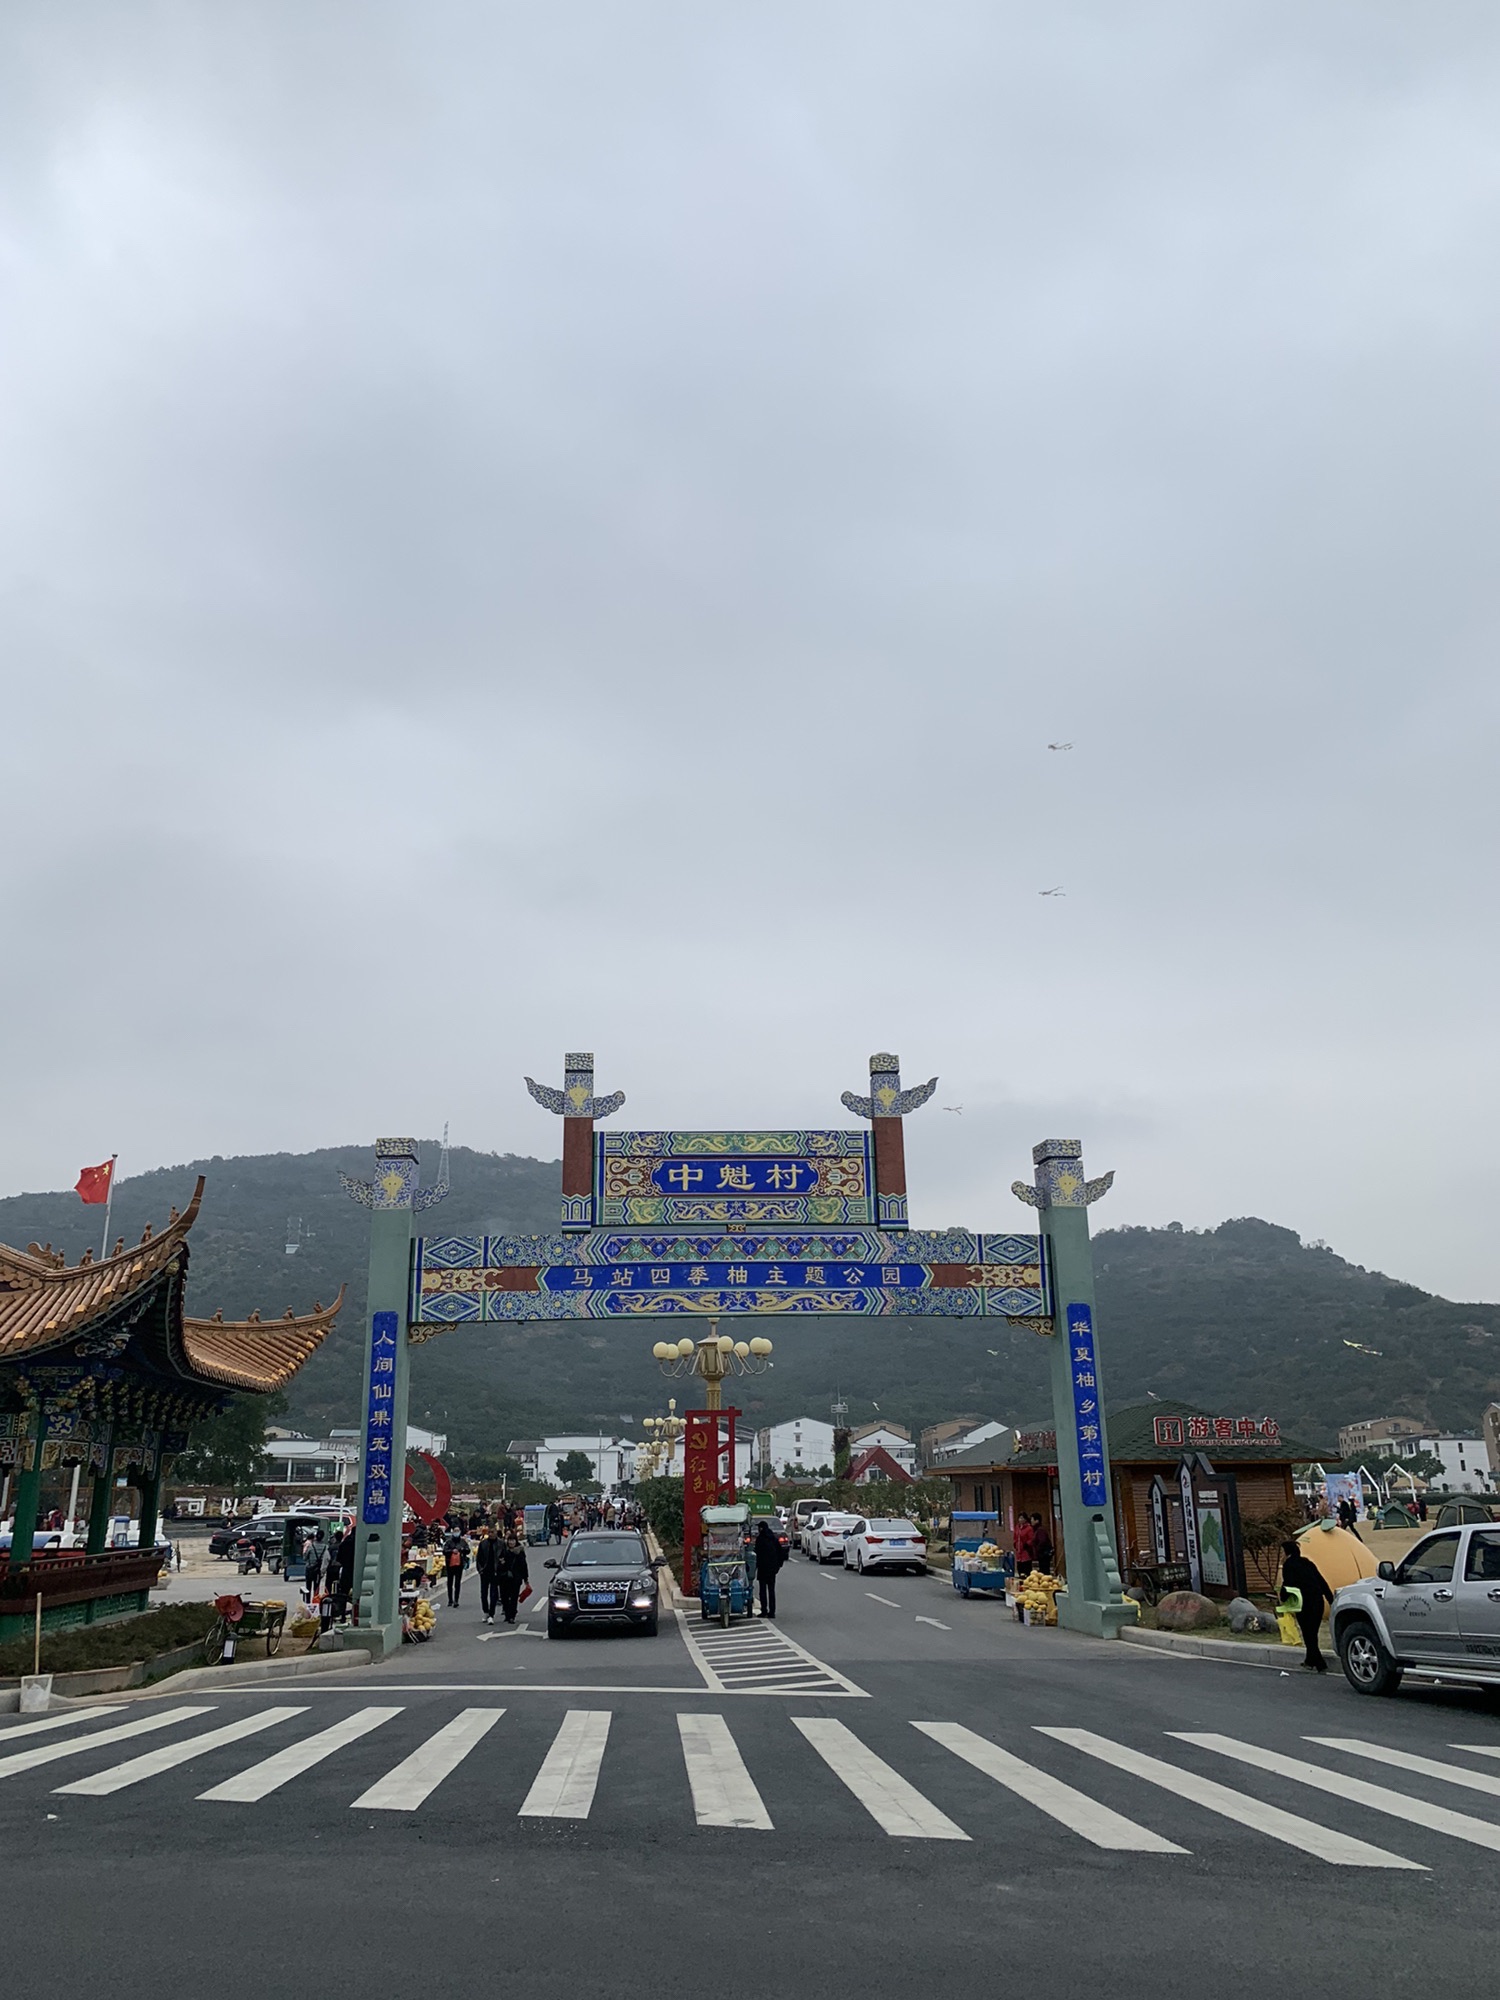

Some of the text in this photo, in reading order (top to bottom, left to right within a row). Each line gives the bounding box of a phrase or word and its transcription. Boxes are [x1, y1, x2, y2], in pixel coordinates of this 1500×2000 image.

[668, 1163, 804, 1191] 中魁村
[570, 1265, 901, 1288] 马站四季柚主题公园
[368, 1330, 395, 1505] 人间仙果无双品
[1071, 1321, 1103, 1487] 华夏柚乡第一村
[1187, 1416, 1280, 1439] 游客中心
